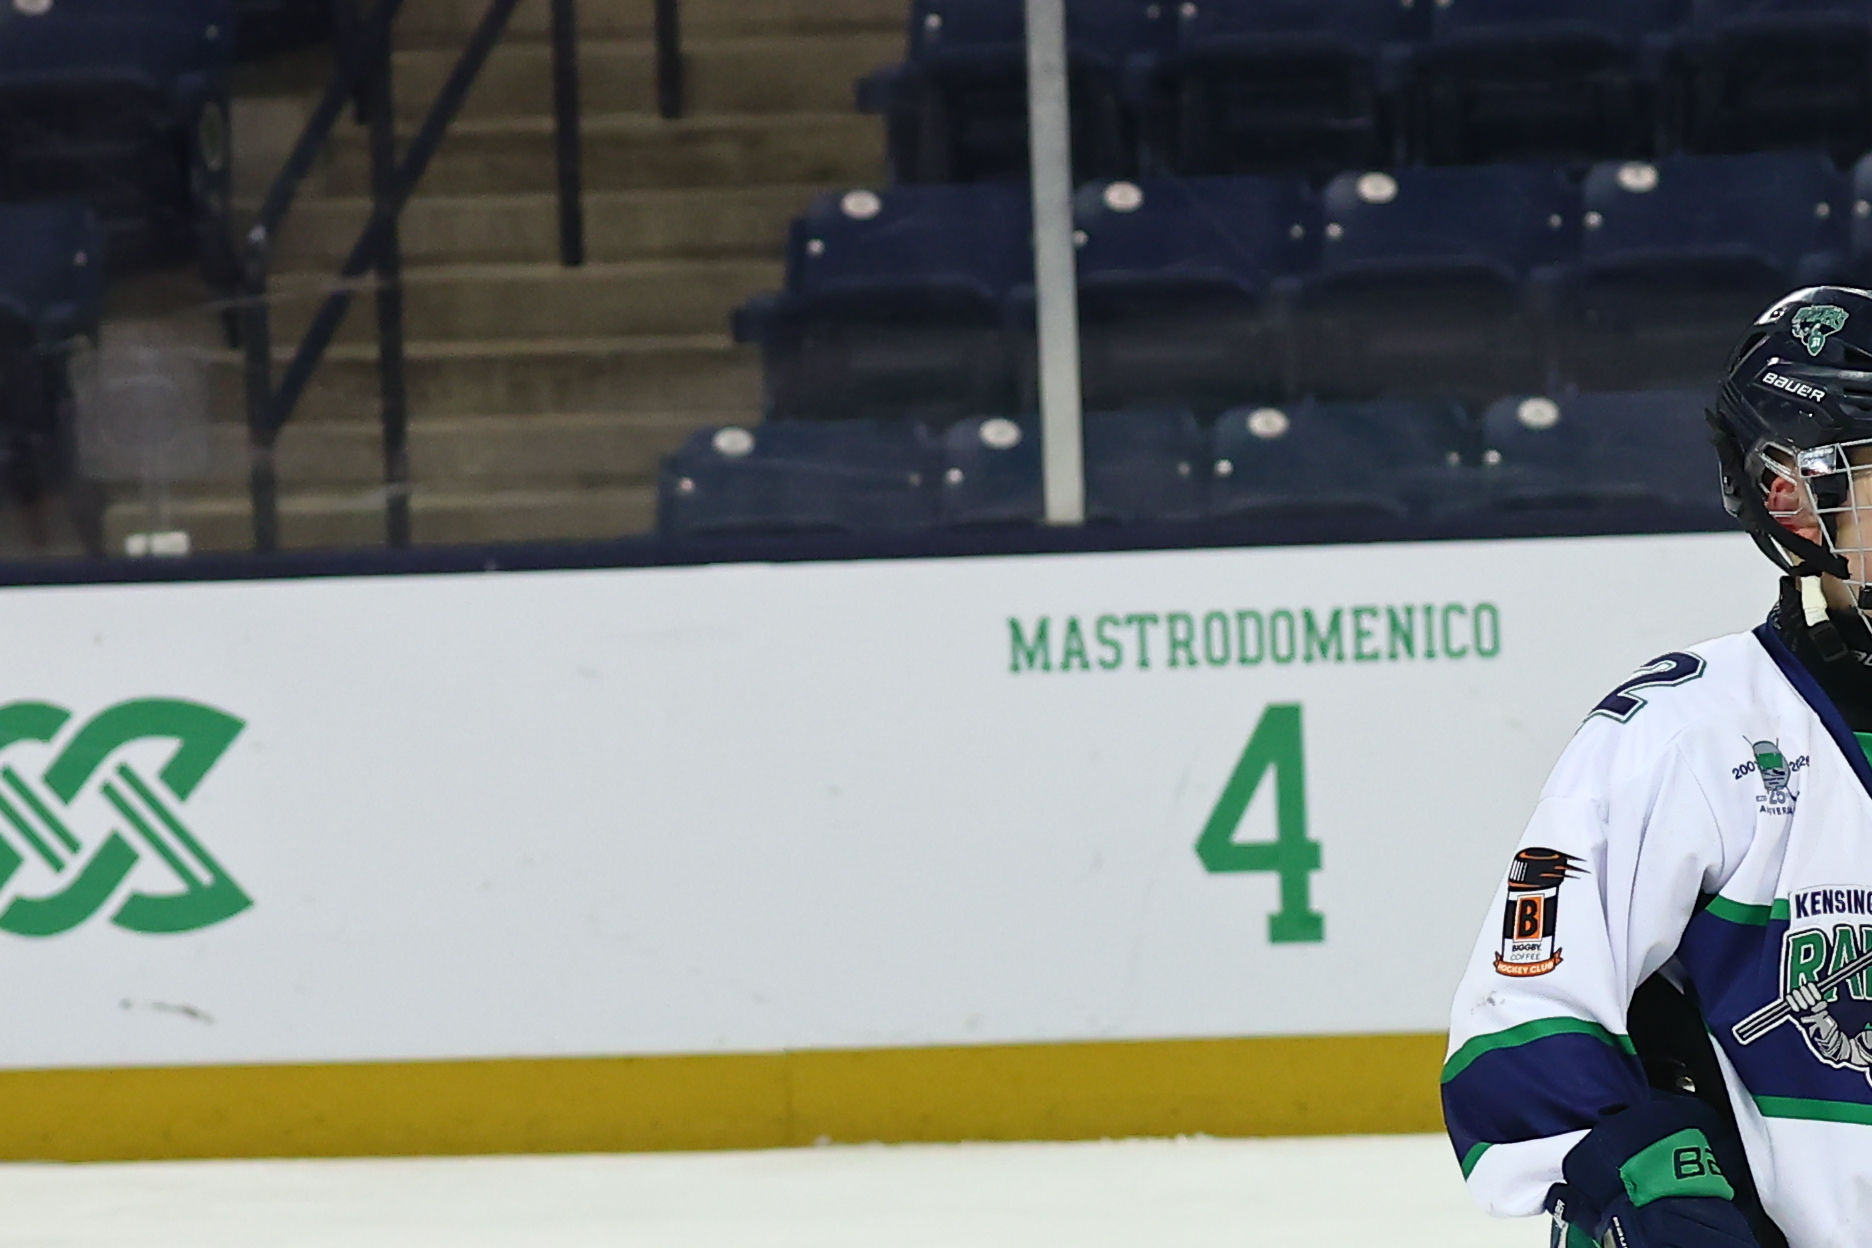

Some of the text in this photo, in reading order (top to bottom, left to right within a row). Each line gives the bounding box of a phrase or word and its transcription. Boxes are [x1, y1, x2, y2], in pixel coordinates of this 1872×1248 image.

[1762, 372, 1825, 402] BAUER
[1007, 602, 1501, 673] MASTRODOMENICO
[1194, 700, 1324, 944] 4
[1519, 898, 1538, 938] B
[1510, 953, 1540, 961] COFFEE
[1530, 961, 1554, 973] CLUB
